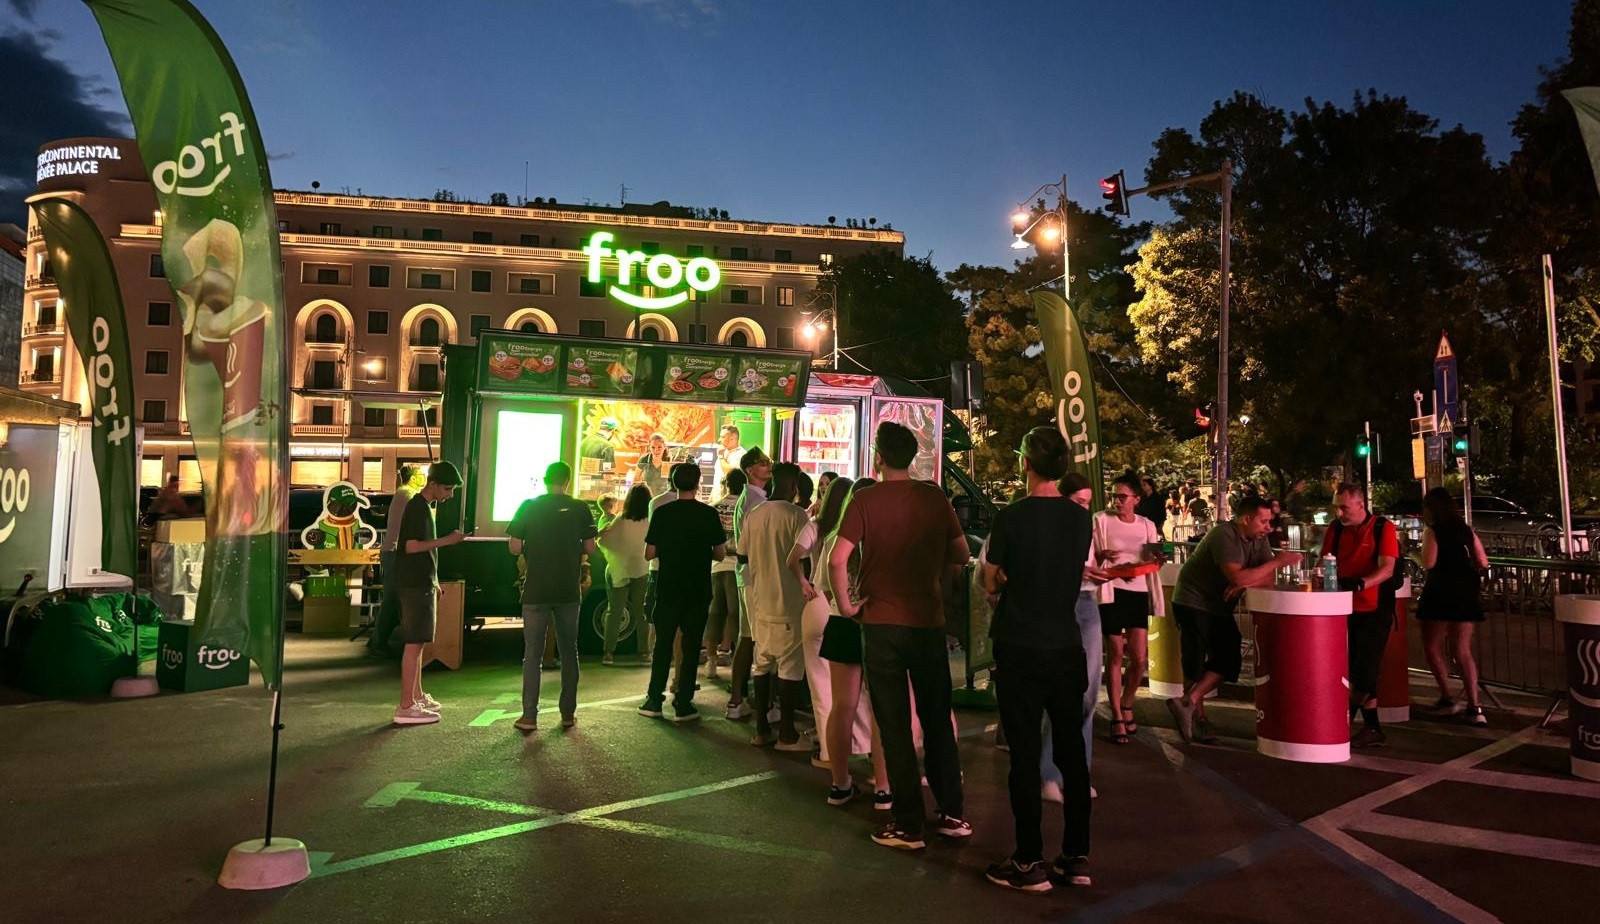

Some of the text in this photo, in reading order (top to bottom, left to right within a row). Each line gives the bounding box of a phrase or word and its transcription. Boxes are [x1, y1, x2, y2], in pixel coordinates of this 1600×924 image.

[56, 160, 98, 175] PALACE
[583, 232, 721, 292] froo
[162, 643, 183, 663] froo
